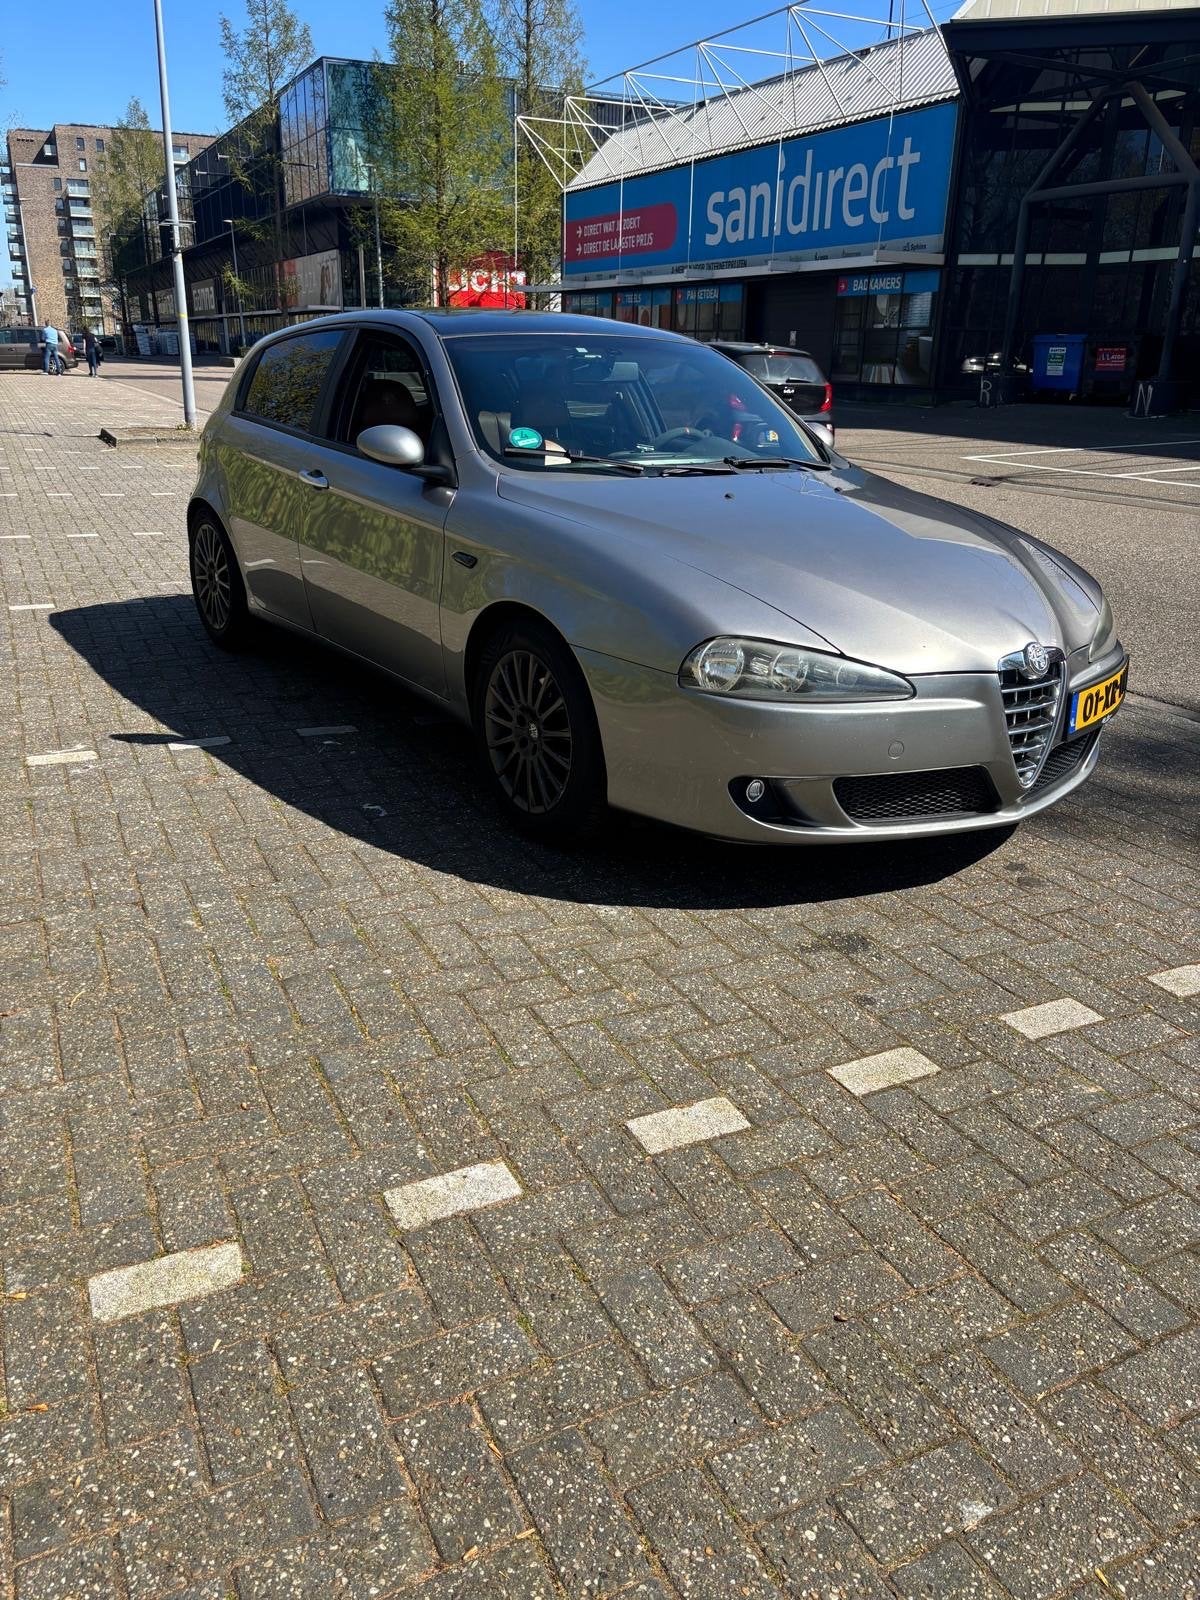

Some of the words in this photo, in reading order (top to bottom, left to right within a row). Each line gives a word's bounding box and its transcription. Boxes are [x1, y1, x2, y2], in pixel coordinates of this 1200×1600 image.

[705, 137, 921, 246] sanidirect
[583, 223, 602, 237] DIRECT
[603, 221, 615, 234] WAT
[623, 216, 641, 230] ZOEKT
[583, 241, 602, 254] DIRECT
[602, 239, 610, 252] DE
[611, 236, 635, 251] LAAGSTE
[636, 232, 654, 246] PRIJS
[853, 276, 902, 291] BADKAMERS
